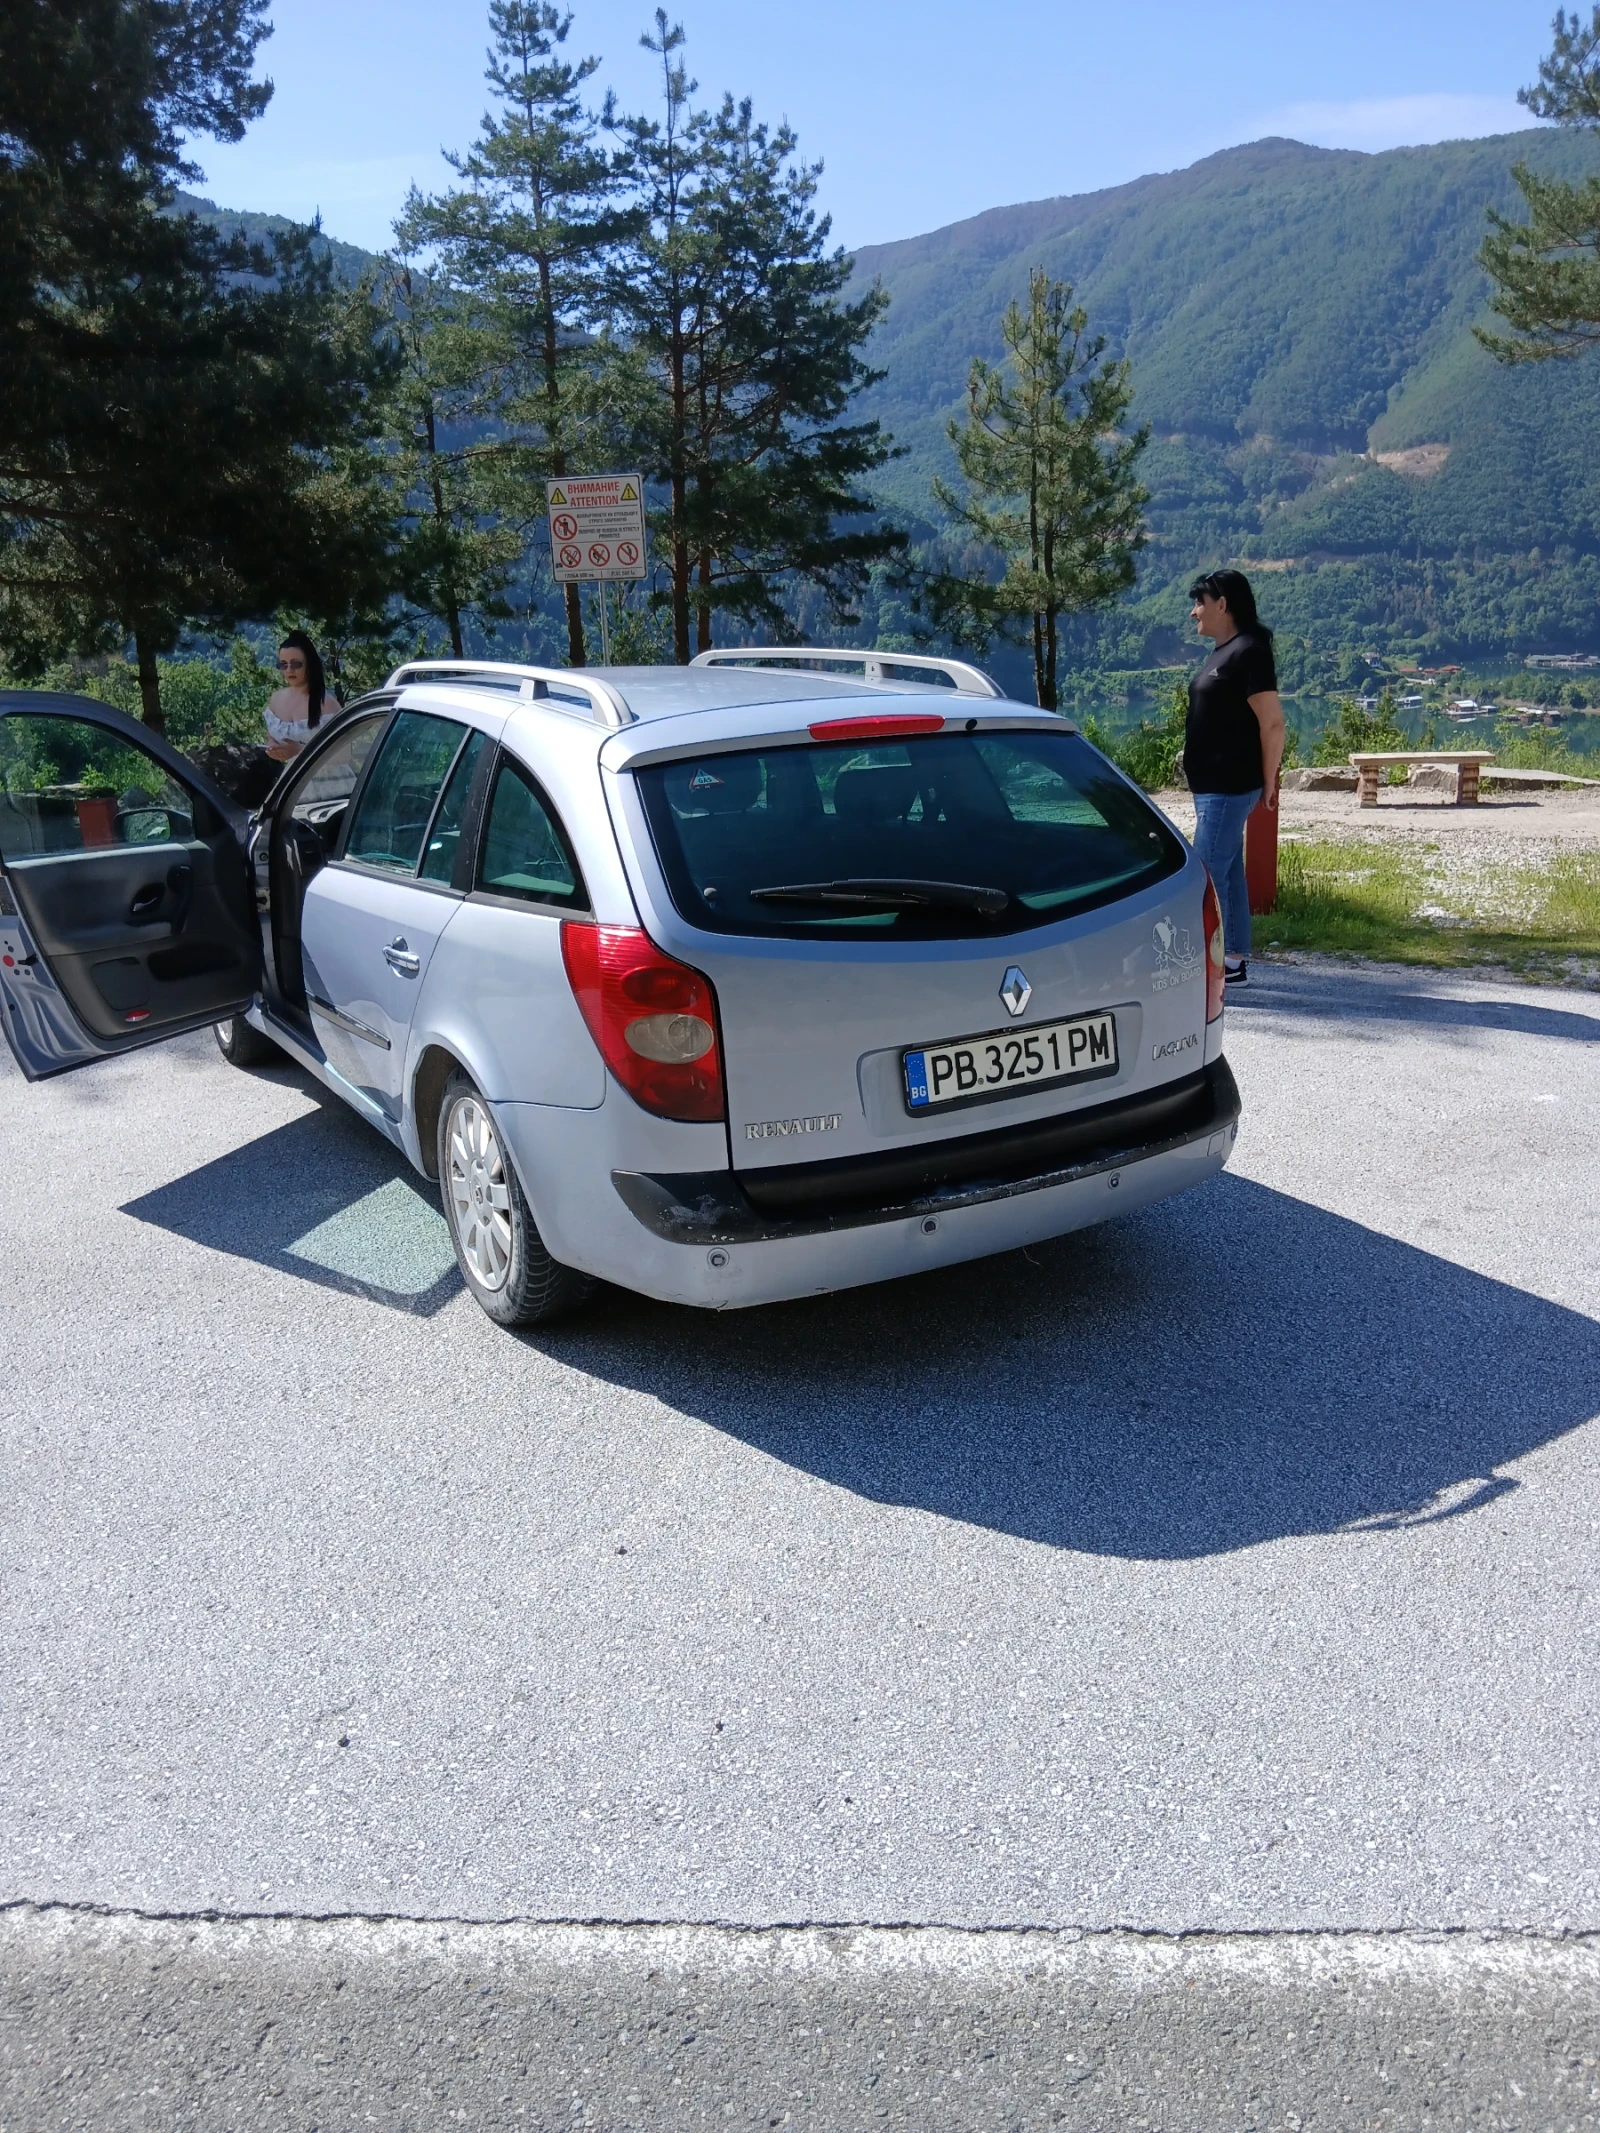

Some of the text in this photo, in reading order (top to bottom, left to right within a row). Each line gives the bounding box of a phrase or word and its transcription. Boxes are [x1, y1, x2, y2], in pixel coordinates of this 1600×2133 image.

[568, 482, 620, 494] ВНИМАНИЕ
[570, 495, 619, 507] ATTENTION
[1152, 967, 1202, 992] KIDS ON BOARD
[1152, 1034, 1198, 1060] LAGUNA
[911, 1085, 927, 1099] BG
[744, 1113, 842, 1140] RENAULT
